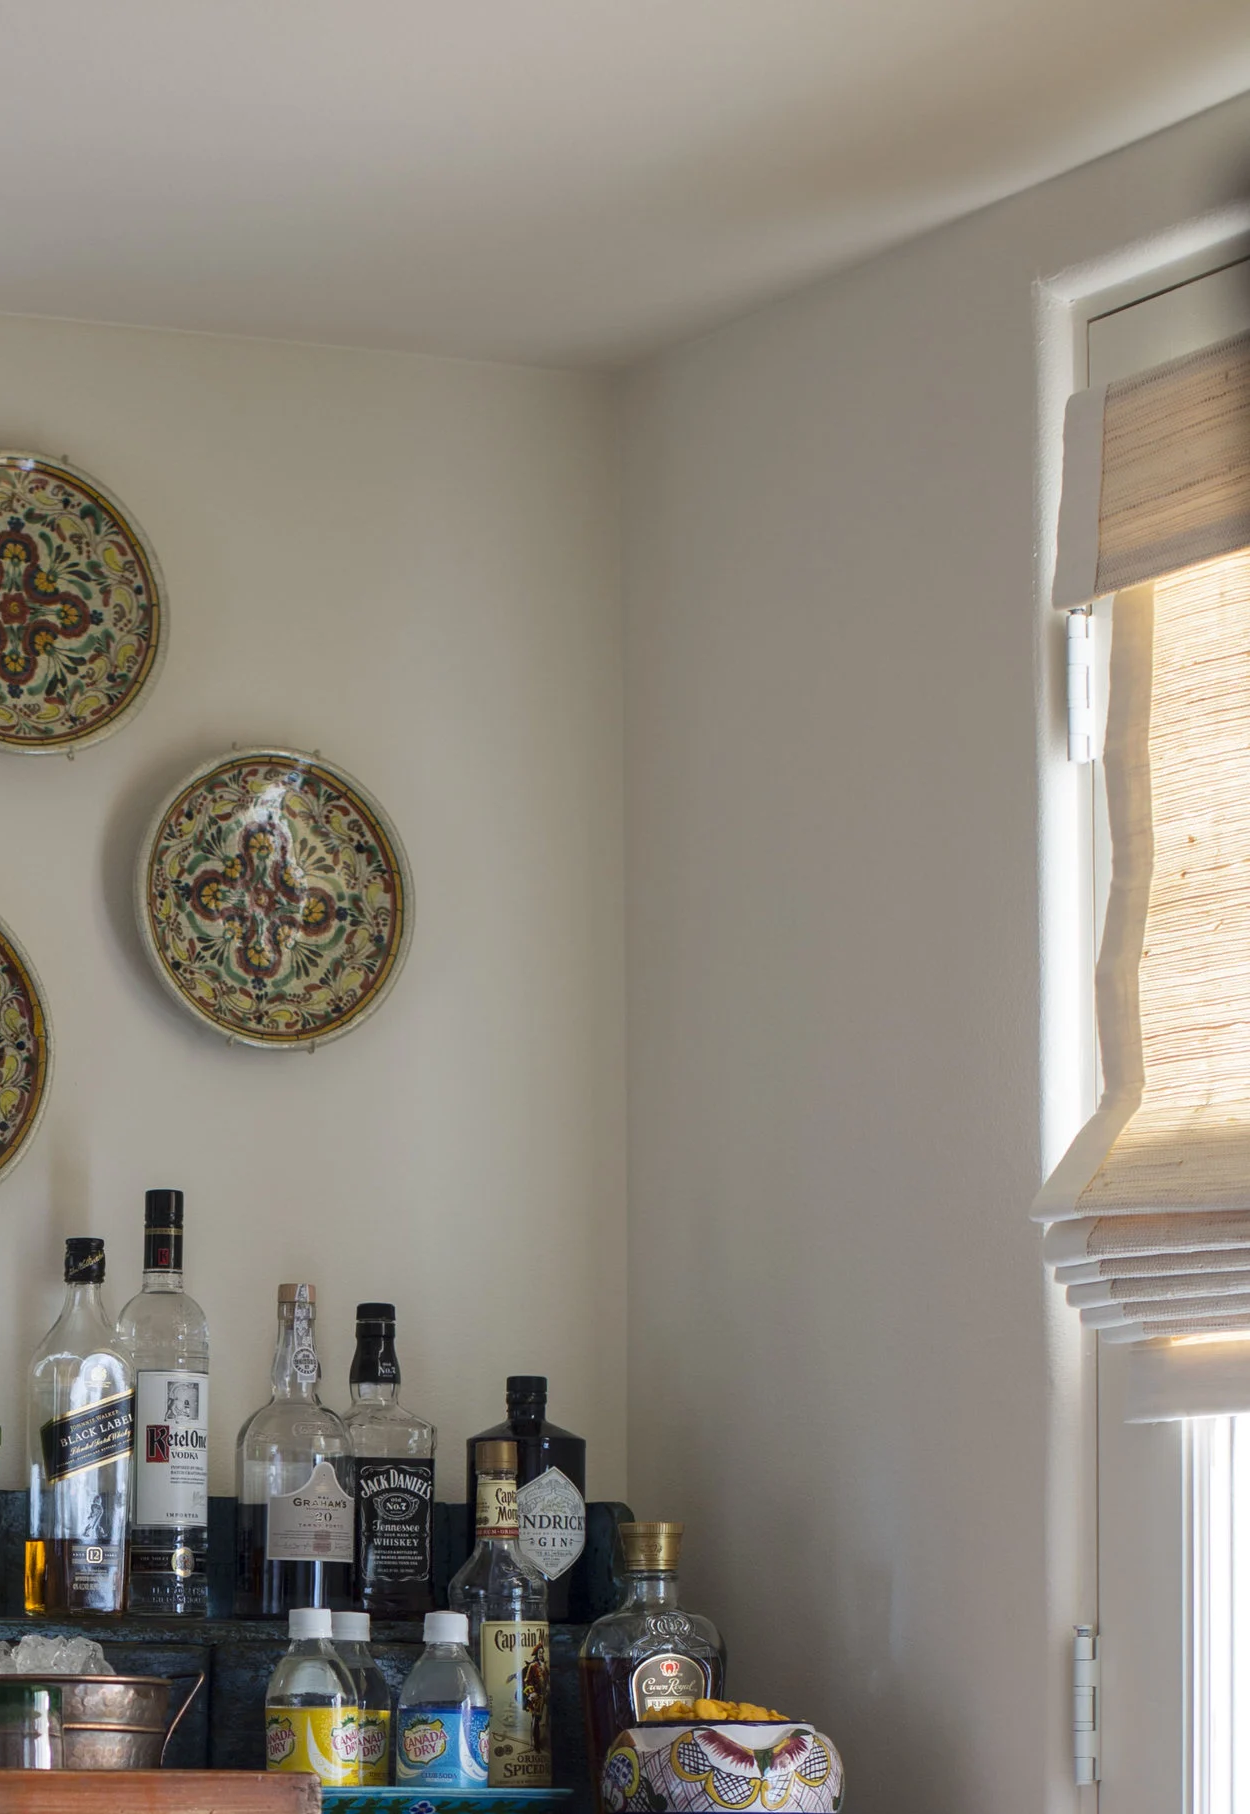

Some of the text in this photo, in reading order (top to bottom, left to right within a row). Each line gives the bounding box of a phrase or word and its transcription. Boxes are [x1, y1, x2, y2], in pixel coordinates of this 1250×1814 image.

[60, 1427, 98, 1447] BLACK
[149, 1427, 189, 1460] Ketel
[171, 1451, 199, 1460] VODKA
[360, 1469, 433, 1499] JACK DANIEL'S
[293, 1497, 347, 1508] GRAHAM'S
[386, 1502, 407, 1511] No.7
[315, 1512, 332, 1521] 20
[372, 1520, 420, 1532] Tennessee
[373, 1538, 419, 1547] WHISKEY
[538, 1537, 568, 1547] GIN
[90, 1550, 100, 1560] 12
[494, 1628, 537, 1653] Captain
[642, 1678, 696, 1696] Crown Royal
[403, 1730, 448, 1752] CANADA
[362, 1743, 382, 1757] DRY
[413, 1743, 437, 1757] DRY
[503, 1763, 545, 1778] SPICED
